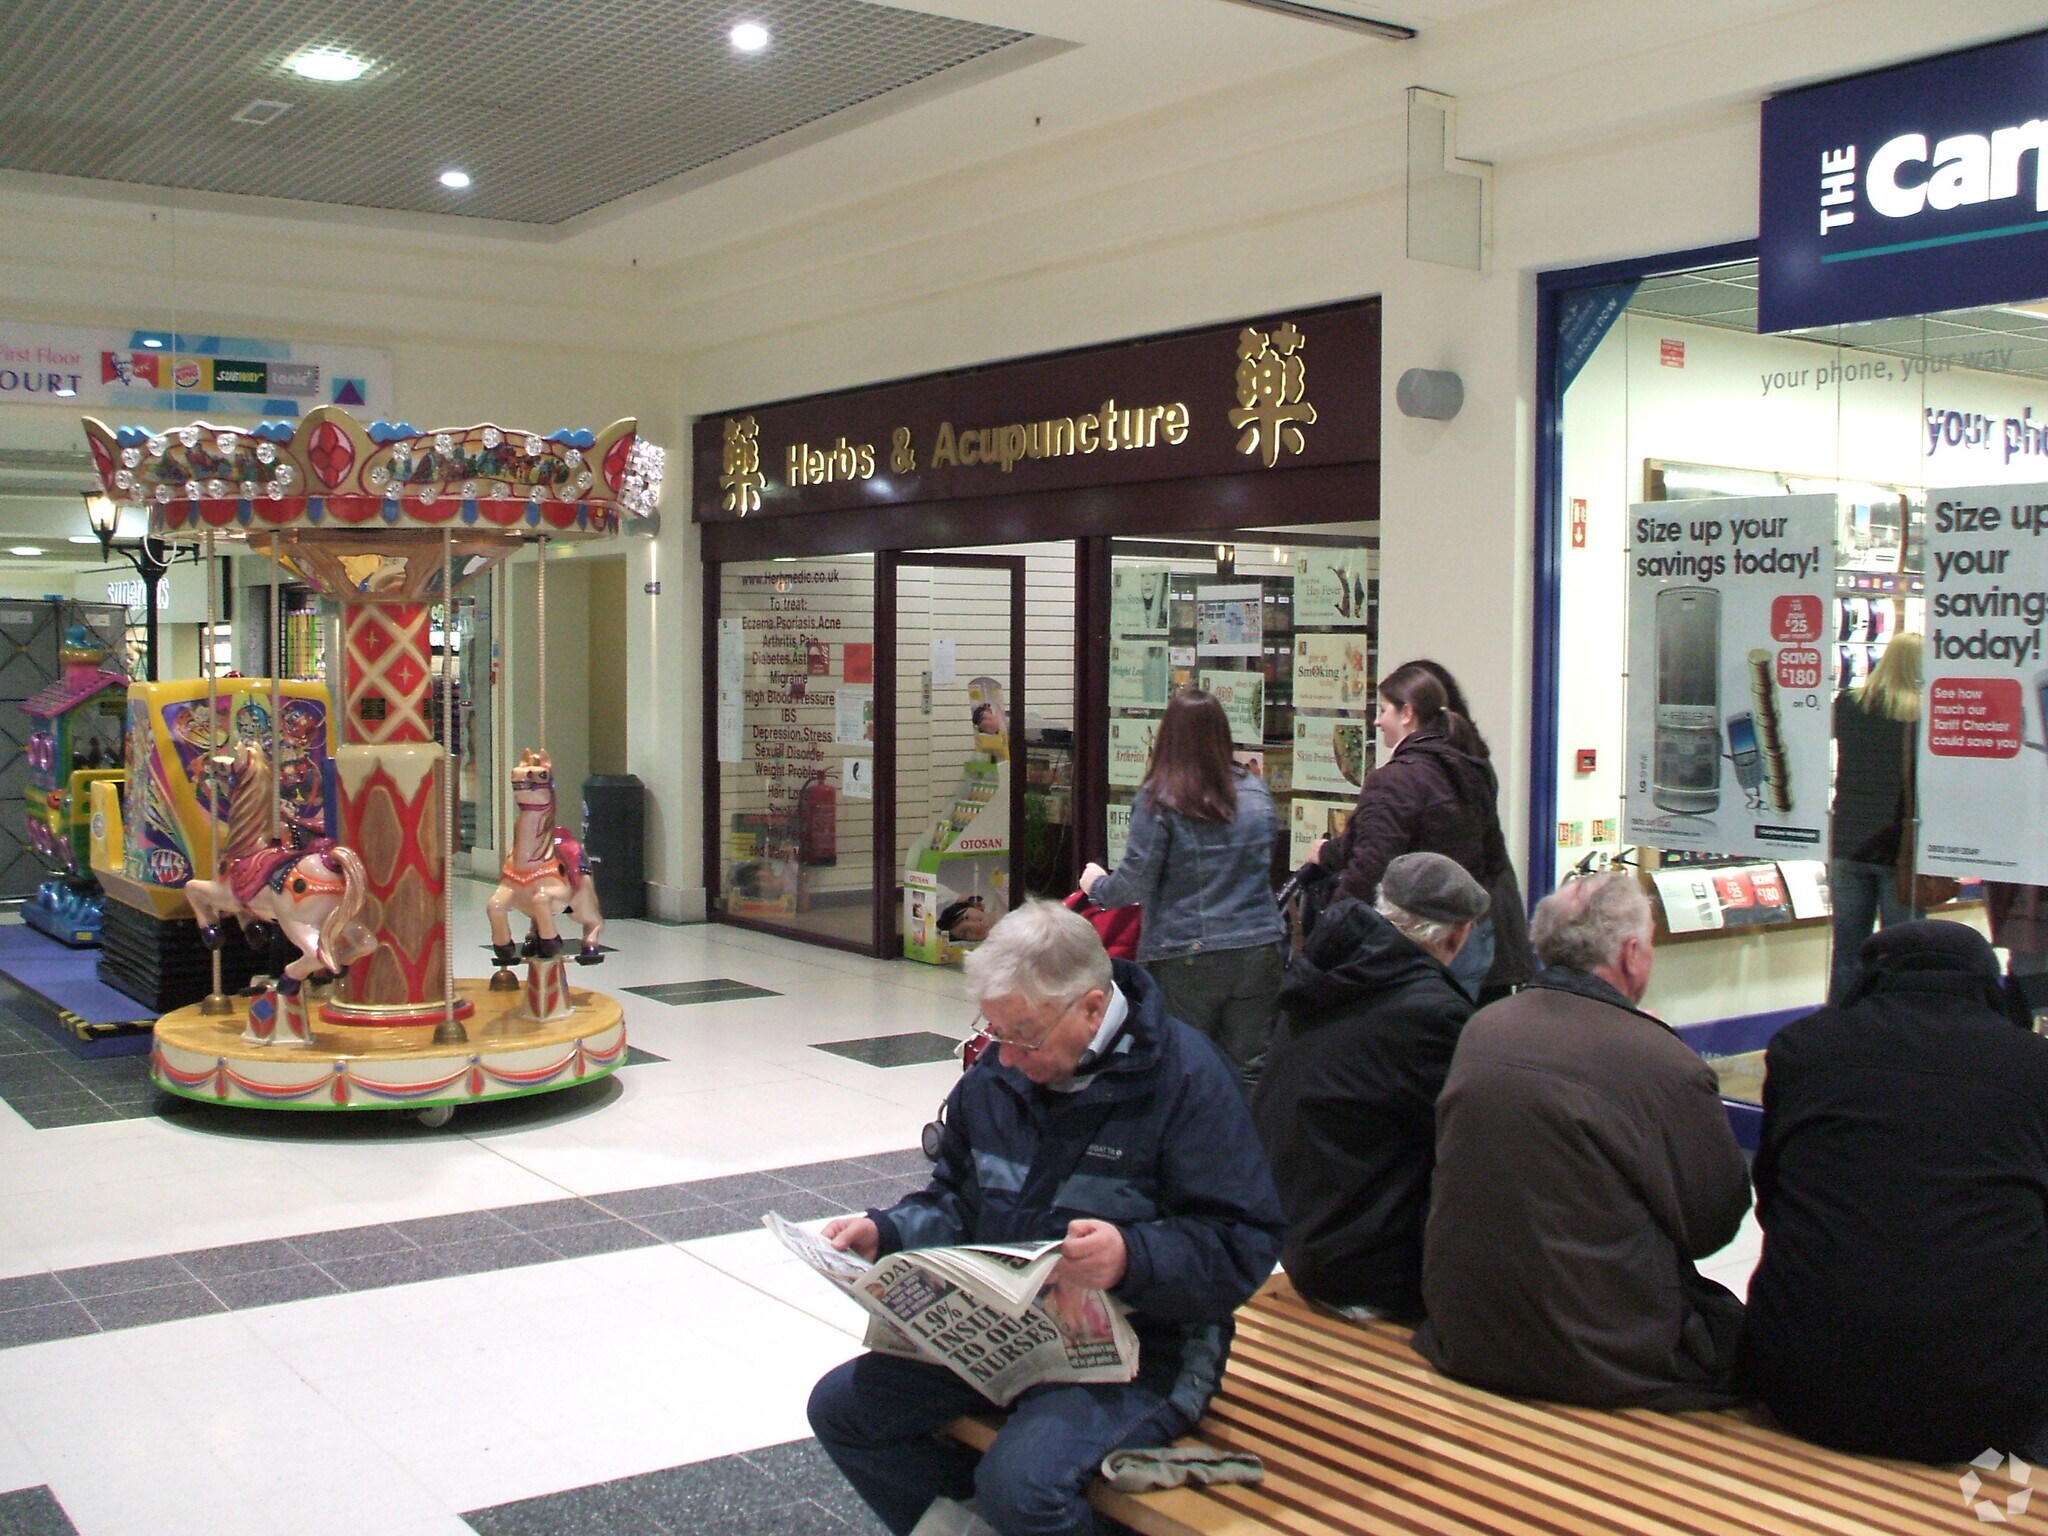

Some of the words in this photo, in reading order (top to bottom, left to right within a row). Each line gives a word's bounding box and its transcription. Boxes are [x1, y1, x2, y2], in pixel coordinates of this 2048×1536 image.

[1820, 144, 1856, 236] THE
[1865, 118, 2048, 218] Car
[0, 346, 30, 362] irst
[37, 348, 82, 365] Floor
[216, 370, 264, 383] SUBWAY
[1761, 368, 1809, 396] your
[1900, 354, 1951, 382] your
[1962, 348, 2014, 371] way
[784, 436, 876, 488] Herbs
[891, 426, 916, 474] &
[931, 399, 1190, 472] Acupuncture
[1925, 408, 1997, 457] your
[2004, 407, 2048, 466] ph
[1935, 501, 2001, 533] Size
[2011, 504, 2048, 536] up
[1636, 518, 1682, 543] Size
[1690, 520, 1722, 546] up
[1729, 517, 1788, 545] your
[1636, 551, 1726, 582] savings
[1734, 546, 1819, 579] today!
[1934, 550, 2010, 582] your
[770, 597, 780, 611] To
[1933, 585, 2048, 626] saving
[1785, 619, 1807, 633] £25
[1933, 628, 2041, 667] today!
[1780, 652, 1818, 665] save
[770, 670, 808, 688] Migraine
[1298, 664, 1340, 682] Smoking
[1781, 668, 1816, 685] £180
[745, 689, 764, 707] High
[1934, 687, 1956, 699] See
[1958, 688, 1983, 699] how
[781, 708, 797, 723] IBS
[1934, 703, 1965, 715] much
[1967, 706, 1987, 715] our
[1933, 718, 1960, 730] Tariff
[1962, 720, 2010, 732] Checker
[755, 743, 784, 757] Sexual
[787, 745, 824, 761] Disorder
[1932, 735, 1965, 747] could
[1967, 738, 1994, 748] save
[1996, 739, 2018, 751] you
[755, 761, 785, 779] Weight
[788, 763, 819, 779] Proble
[767, 784, 784, 799] Hair
[960, 838, 1003, 850] OTOSAN
[909, 875, 929, 884] OTOSAN
[1757, 886, 1780, 901] £180
[911, 1301, 963, 1338] 1.9%
[930, 1304, 1006, 1353] INSUL
[948, 1343, 985, 1366] TO
[967, 1320, 1059, 1383] NURSES
